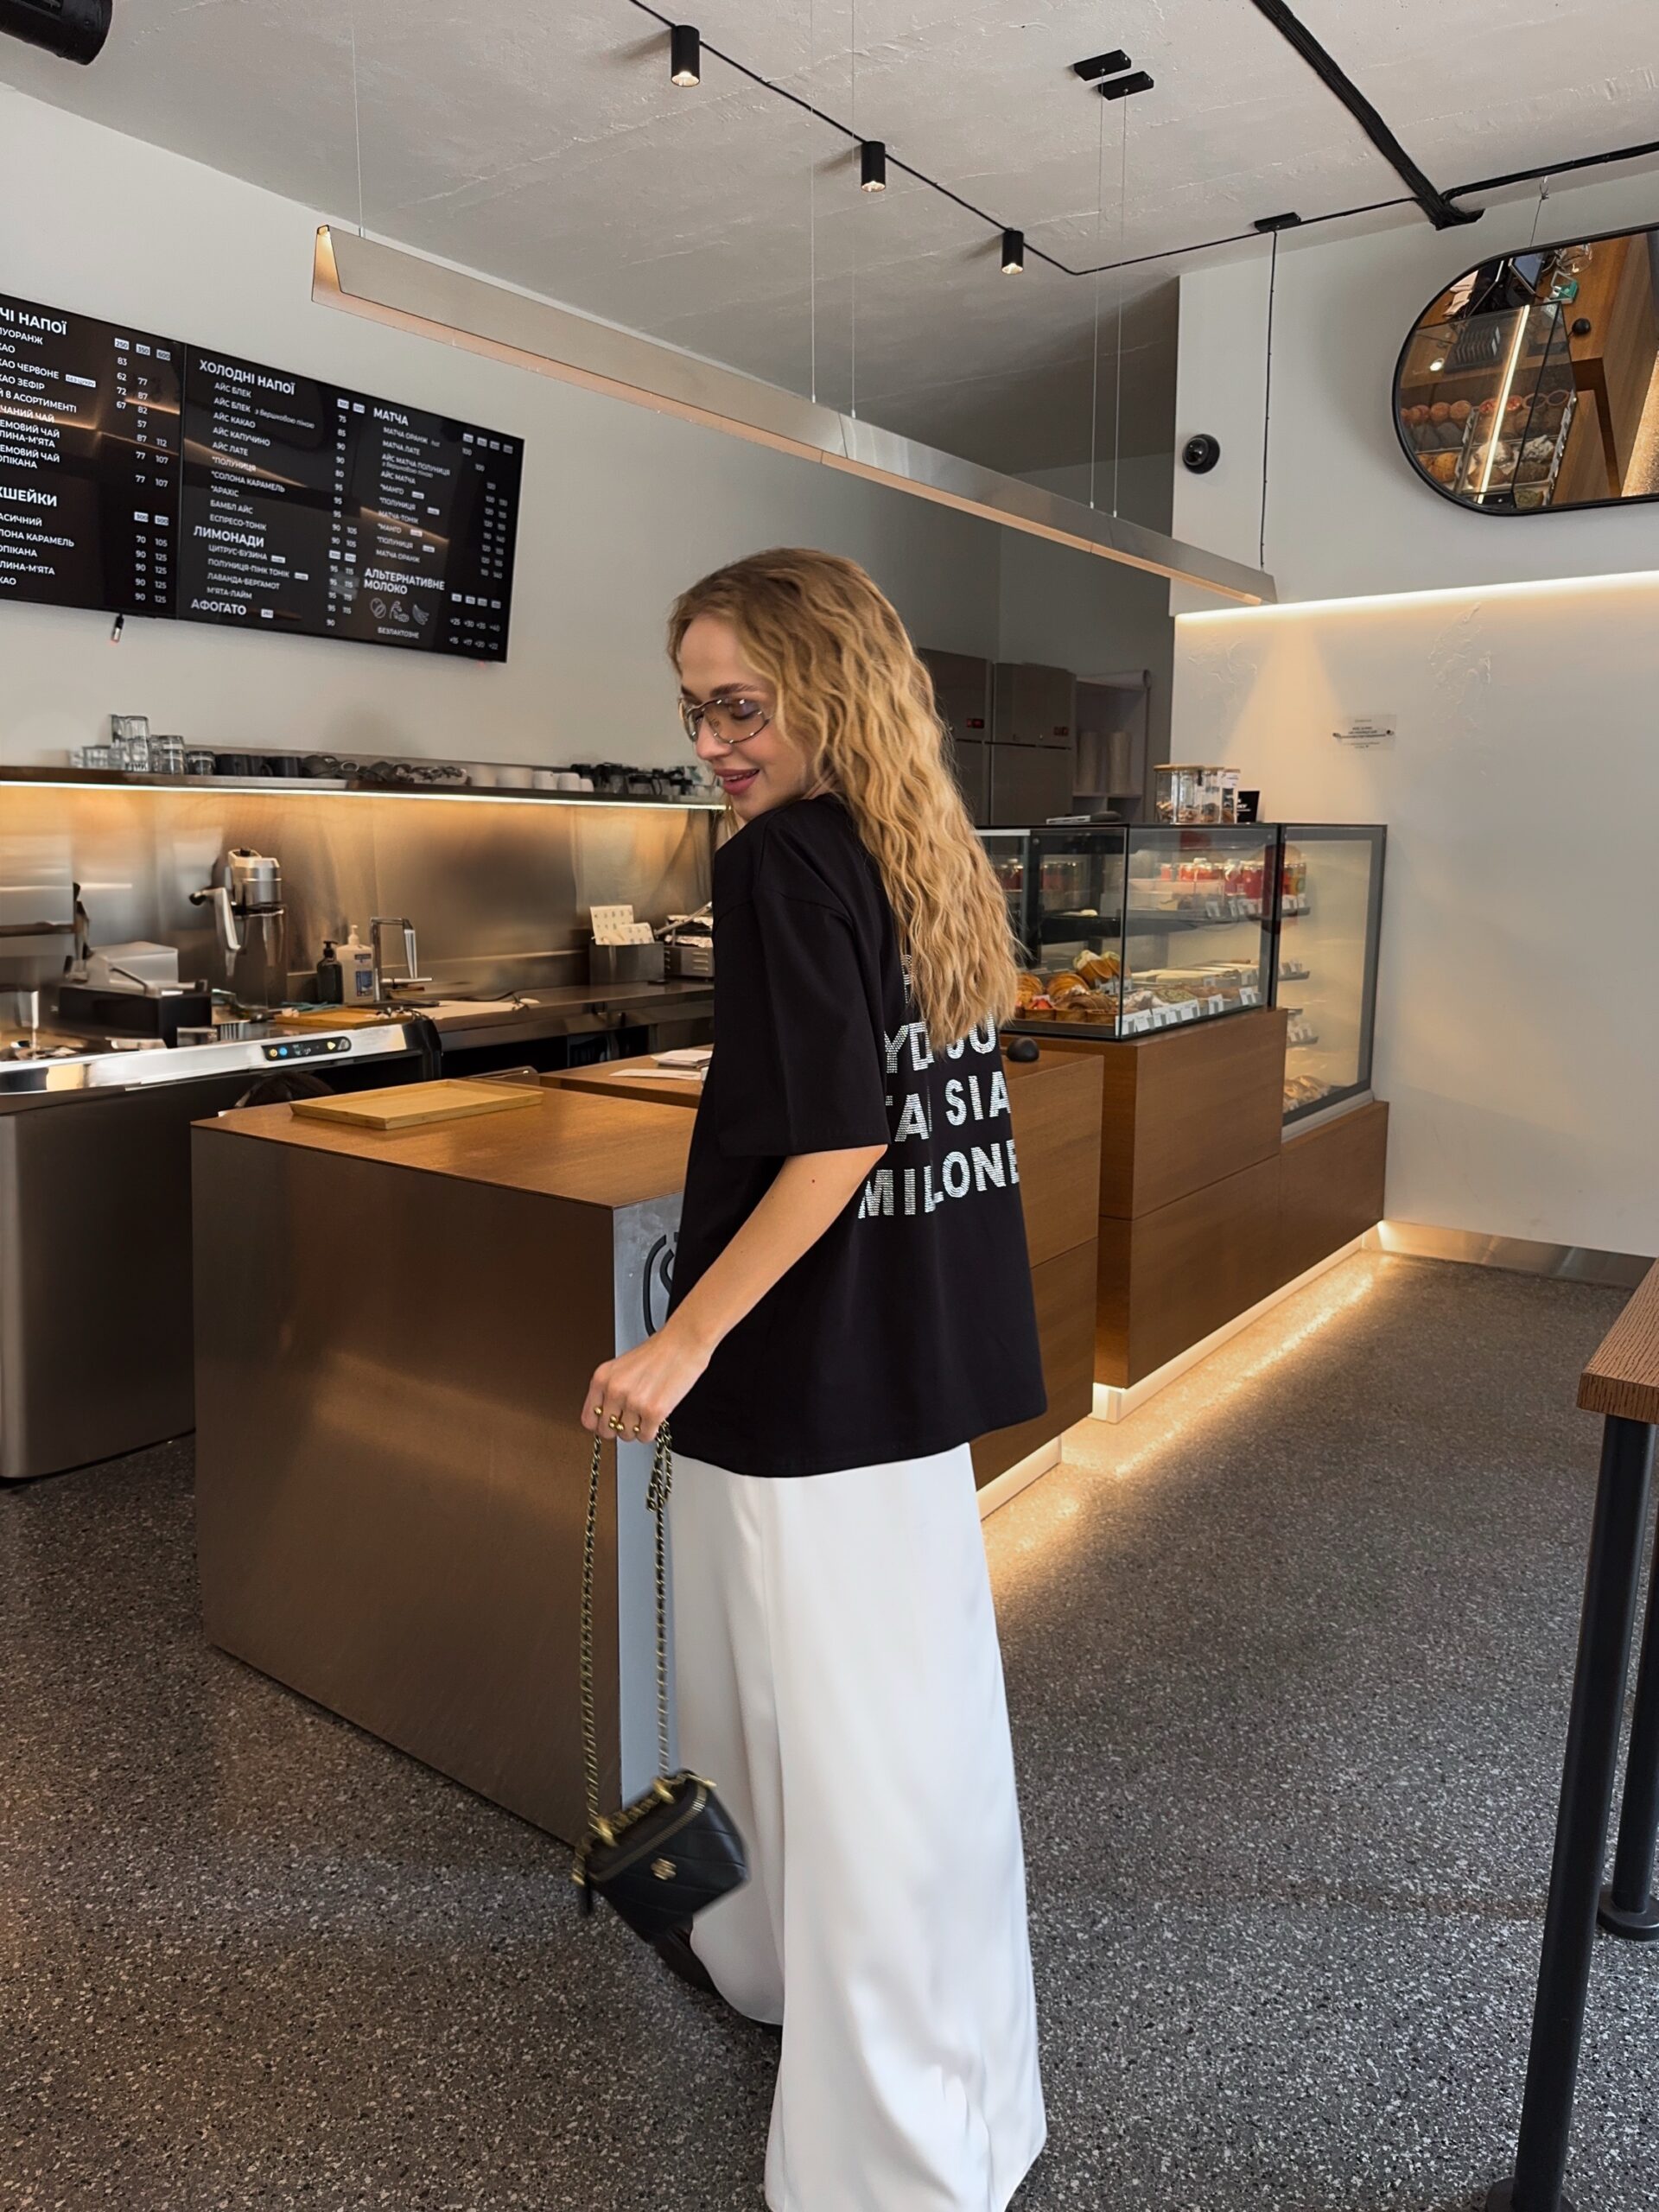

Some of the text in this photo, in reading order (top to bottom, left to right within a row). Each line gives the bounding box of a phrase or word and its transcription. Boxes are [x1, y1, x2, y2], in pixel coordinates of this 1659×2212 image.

[19, 313, 67, 335] НАПОЇ
[118, 357, 127, 366] 83
[17, 363, 60, 379] ЧЕРВОНЕ
[117, 372, 148, 385] 62 77
[199, 359, 296, 395] ХОЛОДНІ НАПОЇ
[17, 378, 45, 391] ЗЕФІР
[214, 382, 251, 398] АЙС БЛЕК
[117, 387, 148, 400] 72 87
[13, 392, 77, 413] АСОРТИМЕНТІ
[117, 401, 148, 415] 67 82
[213, 397, 230, 408] АЙС
[231, 401, 251, 413] БЛЕК
[35, 411, 55, 423] ЧАЙ
[137, 420, 147, 429] 57
[213, 411, 256, 429] АЙС КАКАО
[373, 408, 409, 426] МАТЧА
[41, 429, 60, 440] ЧАЙ
[213, 426, 270, 447] АЙС КАПУЧИНО
[383, 427, 404, 438] МАТЧА
[137, 434, 167, 447] 87 112
[382, 440, 421, 456] МАТЧА ЛАТЕ
[213, 442, 249, 457] АЙС ЛАТЕ
[41, 452, 60, 463] ЧАЙ
[136, 451, 168, 464] 77 107
[396, 457, 416, 467] МАТЧА
[136, 474, 168, 487] 77 107
[246, 478, 285, 493] КАРАМЕЛЬ
[395, 474, 416, 485] МАТЧА
[210, 499, 254, 515] БАМБЛ АЙС
[209, 513, 267, 531] ЕСПРЕСО-ТОНІК
[26, 532, 74, 547] КАРАМЕЛЬ
[155, 538, 168, 547] 105
[194, 525, 264, 548] ЛИМОНАДИ
[136, 550, 167, 562] 90 125
[208, 544, 268, 561] ЦИТРУС-БУЗИНА
[376, 549, 397, 559] МАТЧА
[155, 566, 167, 575] 125
[207, 557, 268, 575] ПОЛУНИЦЯ-ПІНК
[269, 567, 290, 578] ТОНІК
[135, 578, 167, 589] 90 125
[207, 572, 281, 590] ЛАВАНДА-БЕРГАМОТ
[364, 579, 408, 595] МОЛОКО
[365, 568, 445, 591] АЛЬТЕРНАТИВНЕ
[155, 594, 167, 603] 125
[191, 598, 247, 616] АФОГАТО
